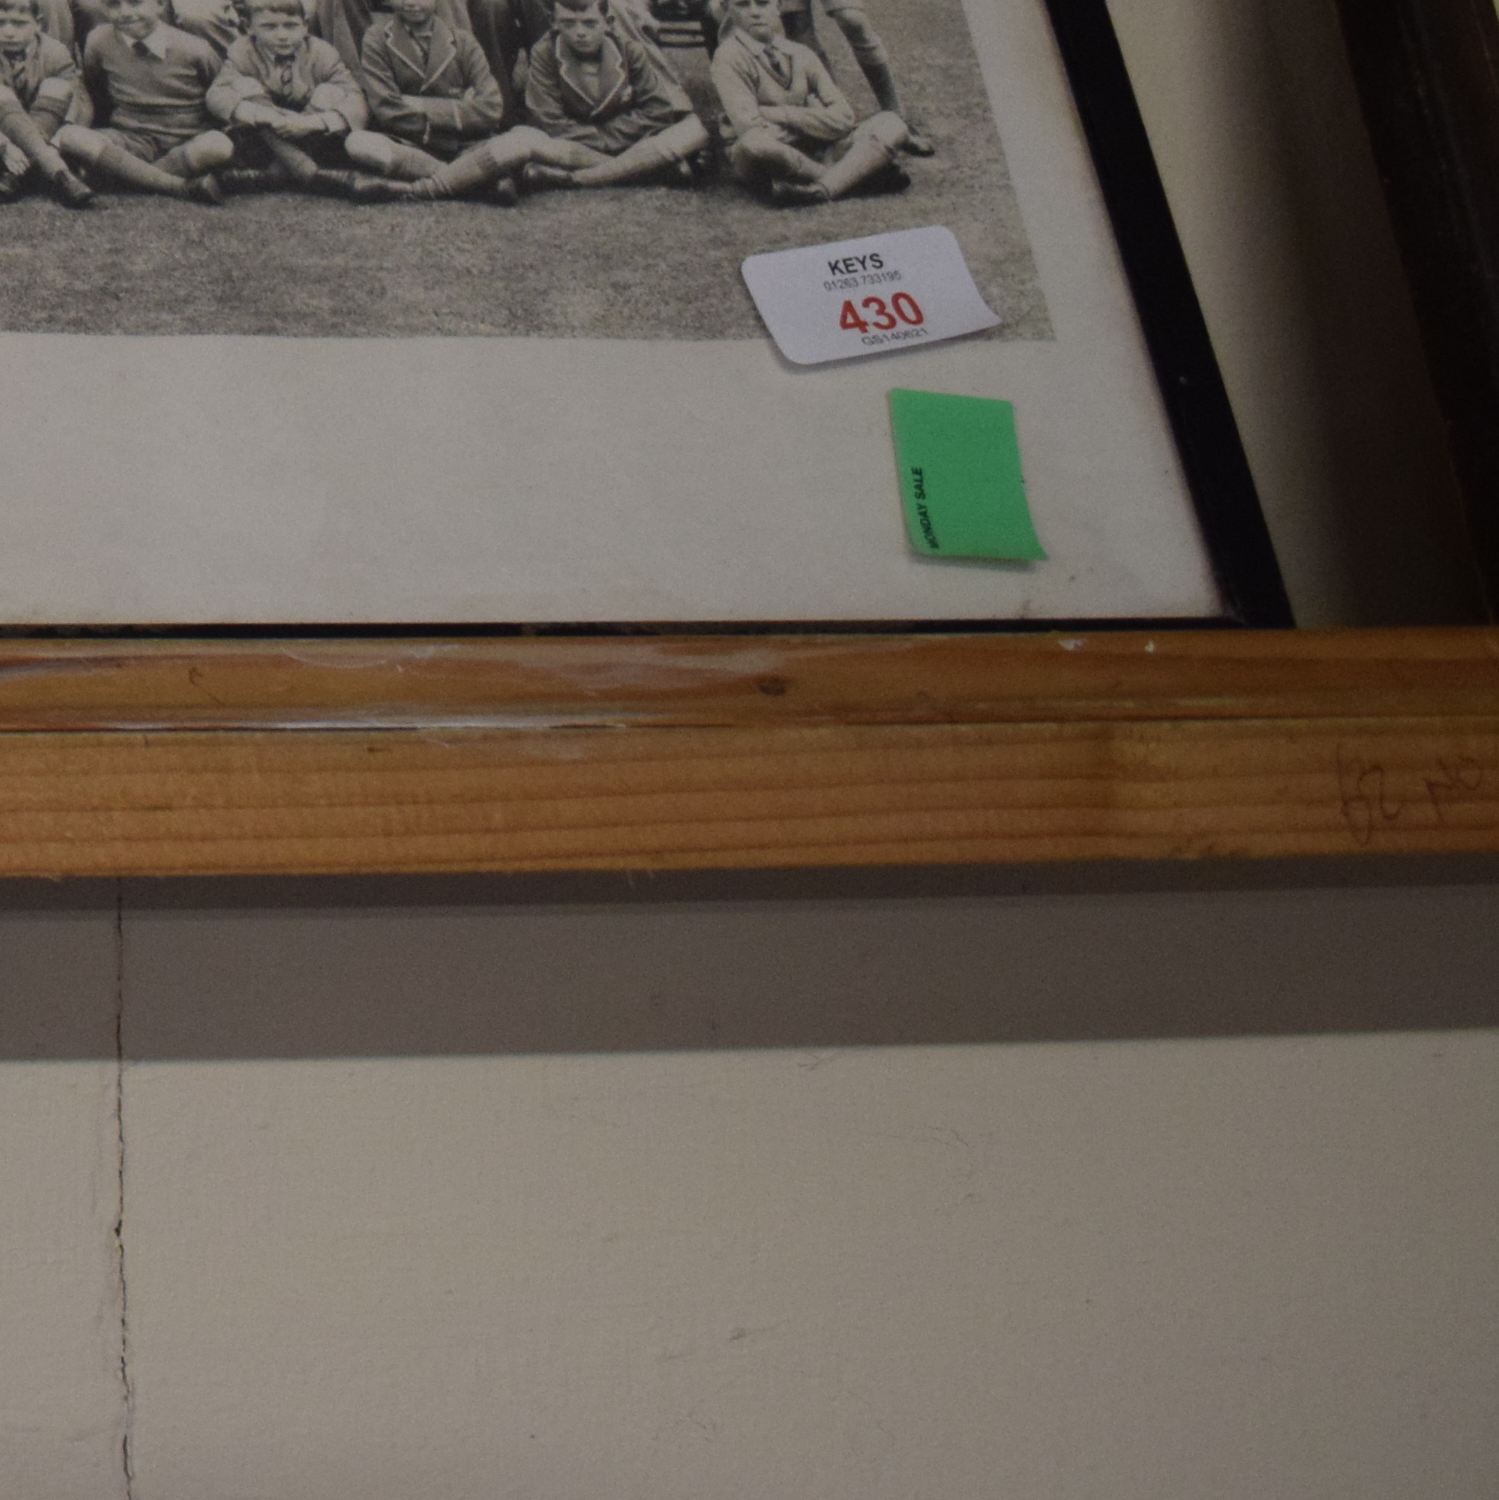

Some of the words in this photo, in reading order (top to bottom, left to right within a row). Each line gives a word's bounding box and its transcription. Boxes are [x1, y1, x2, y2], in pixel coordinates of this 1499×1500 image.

[828, 253, 883, 276] KEYS
[840, 292, 924, 333] 430
[911, 467, 926, 499] SALE
[916, 503, 940, 549] MONDAY
